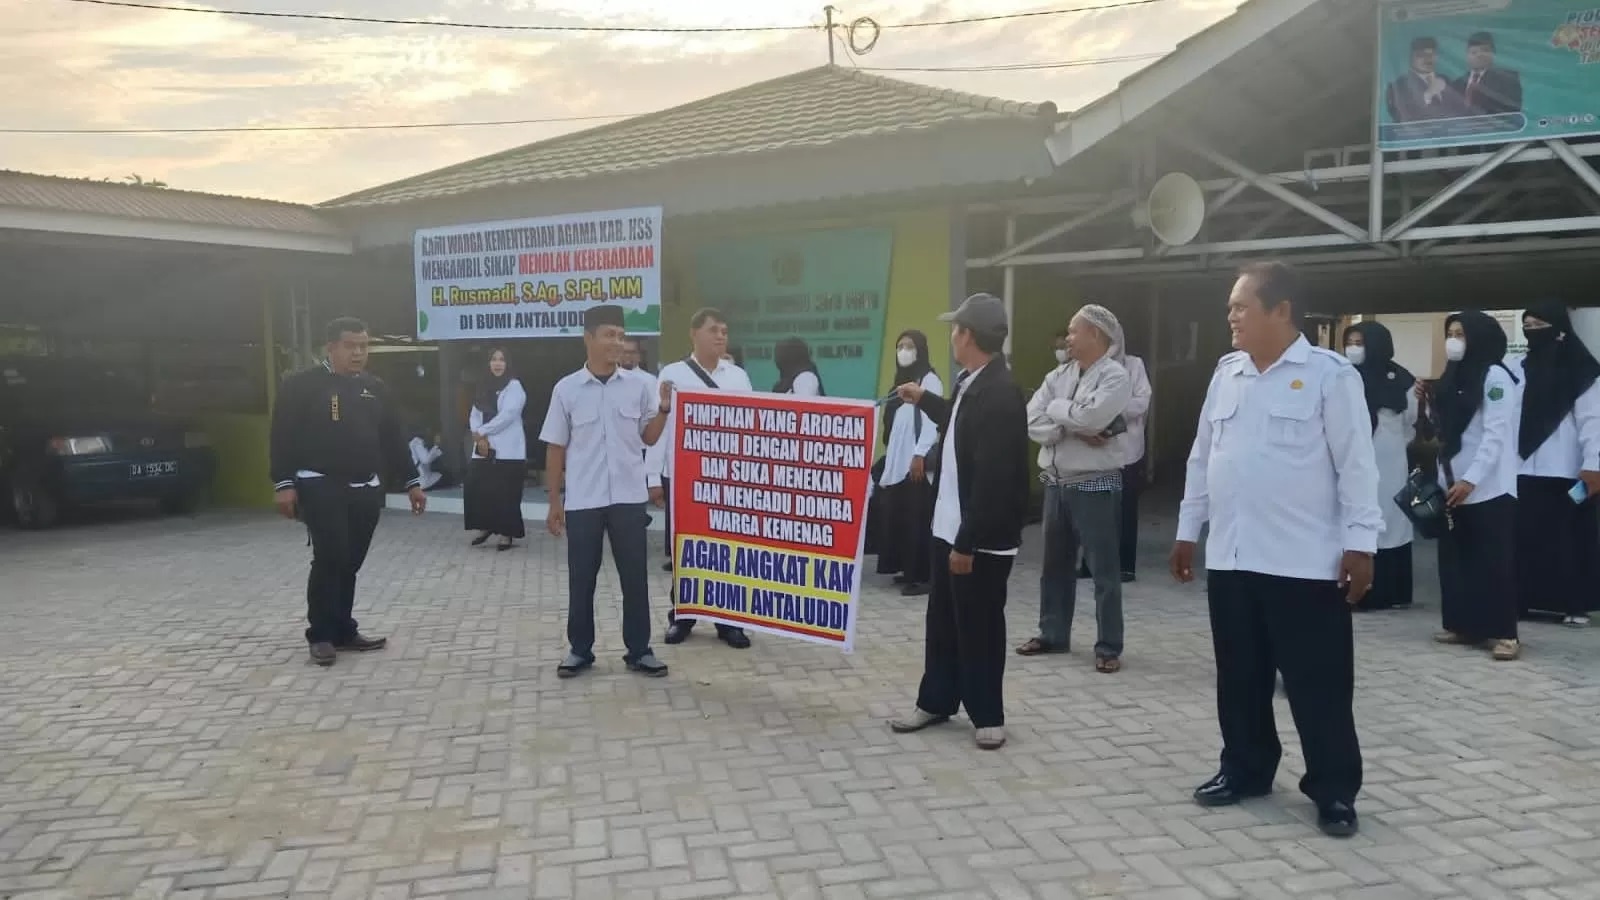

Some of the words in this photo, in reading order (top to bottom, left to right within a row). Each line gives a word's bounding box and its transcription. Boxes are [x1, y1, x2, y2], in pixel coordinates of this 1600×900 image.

[448, 231, 483, 255] WARGA
[484, 226, 555, 252] KEMENTERIAN
[557, 221, 597, 247] AGAMA
[600, 219, 626, 243] KAB.
[628, 217, 653, 240] HSS
[422, 257, 482, 281] MENGAMBIL
[484, 255, 516, 277] SIKAP
[518, 250, 570, 275] MENOLAK
[574, 245, 654, 271] KEBERADAAN
[431, 286, 448, 307] H.
[449, 282, 520, 307] Rusmadi,
[564, 276, 608, 303] S.Pd,
[609, 275, 643, 300] MM
[459, 315, 473, 331] DI
[476, 313, 512, 330] BUMI
[514, 311, 585, 329] ANTALUDD
[683, 402, 755, 430] PIMPINAN
[758, 408, 797, 434] YANG
[799, 412, 865, 440] AROGAN
[683, 428, 740, 455] ANGKUH
[742, 434, 800, 462] DENGAN
[802, 440, 865, 469] UCAPAN
[701, 456, 728, 480] DAN
[730, 459, 770, 485] SUKA
[772, 464, 844, 494] MENEKAN
[693, 481, 721, 504] DAN
[723, 484, 792, 515] MENGADU
[795, 493, 853, 522] DOMBA
[708, 508, 760, 537] WARGA
[762, 516, 833, 547] KEMENAG
[681, 539, 731, 573] AGAR
[734, 547, 809, 586] ANGKAT
[679, 577, 699, 604] DI
[703, 580, 747, 613] BUMI
[751, 588, 849, 631] ANTALUDDI
